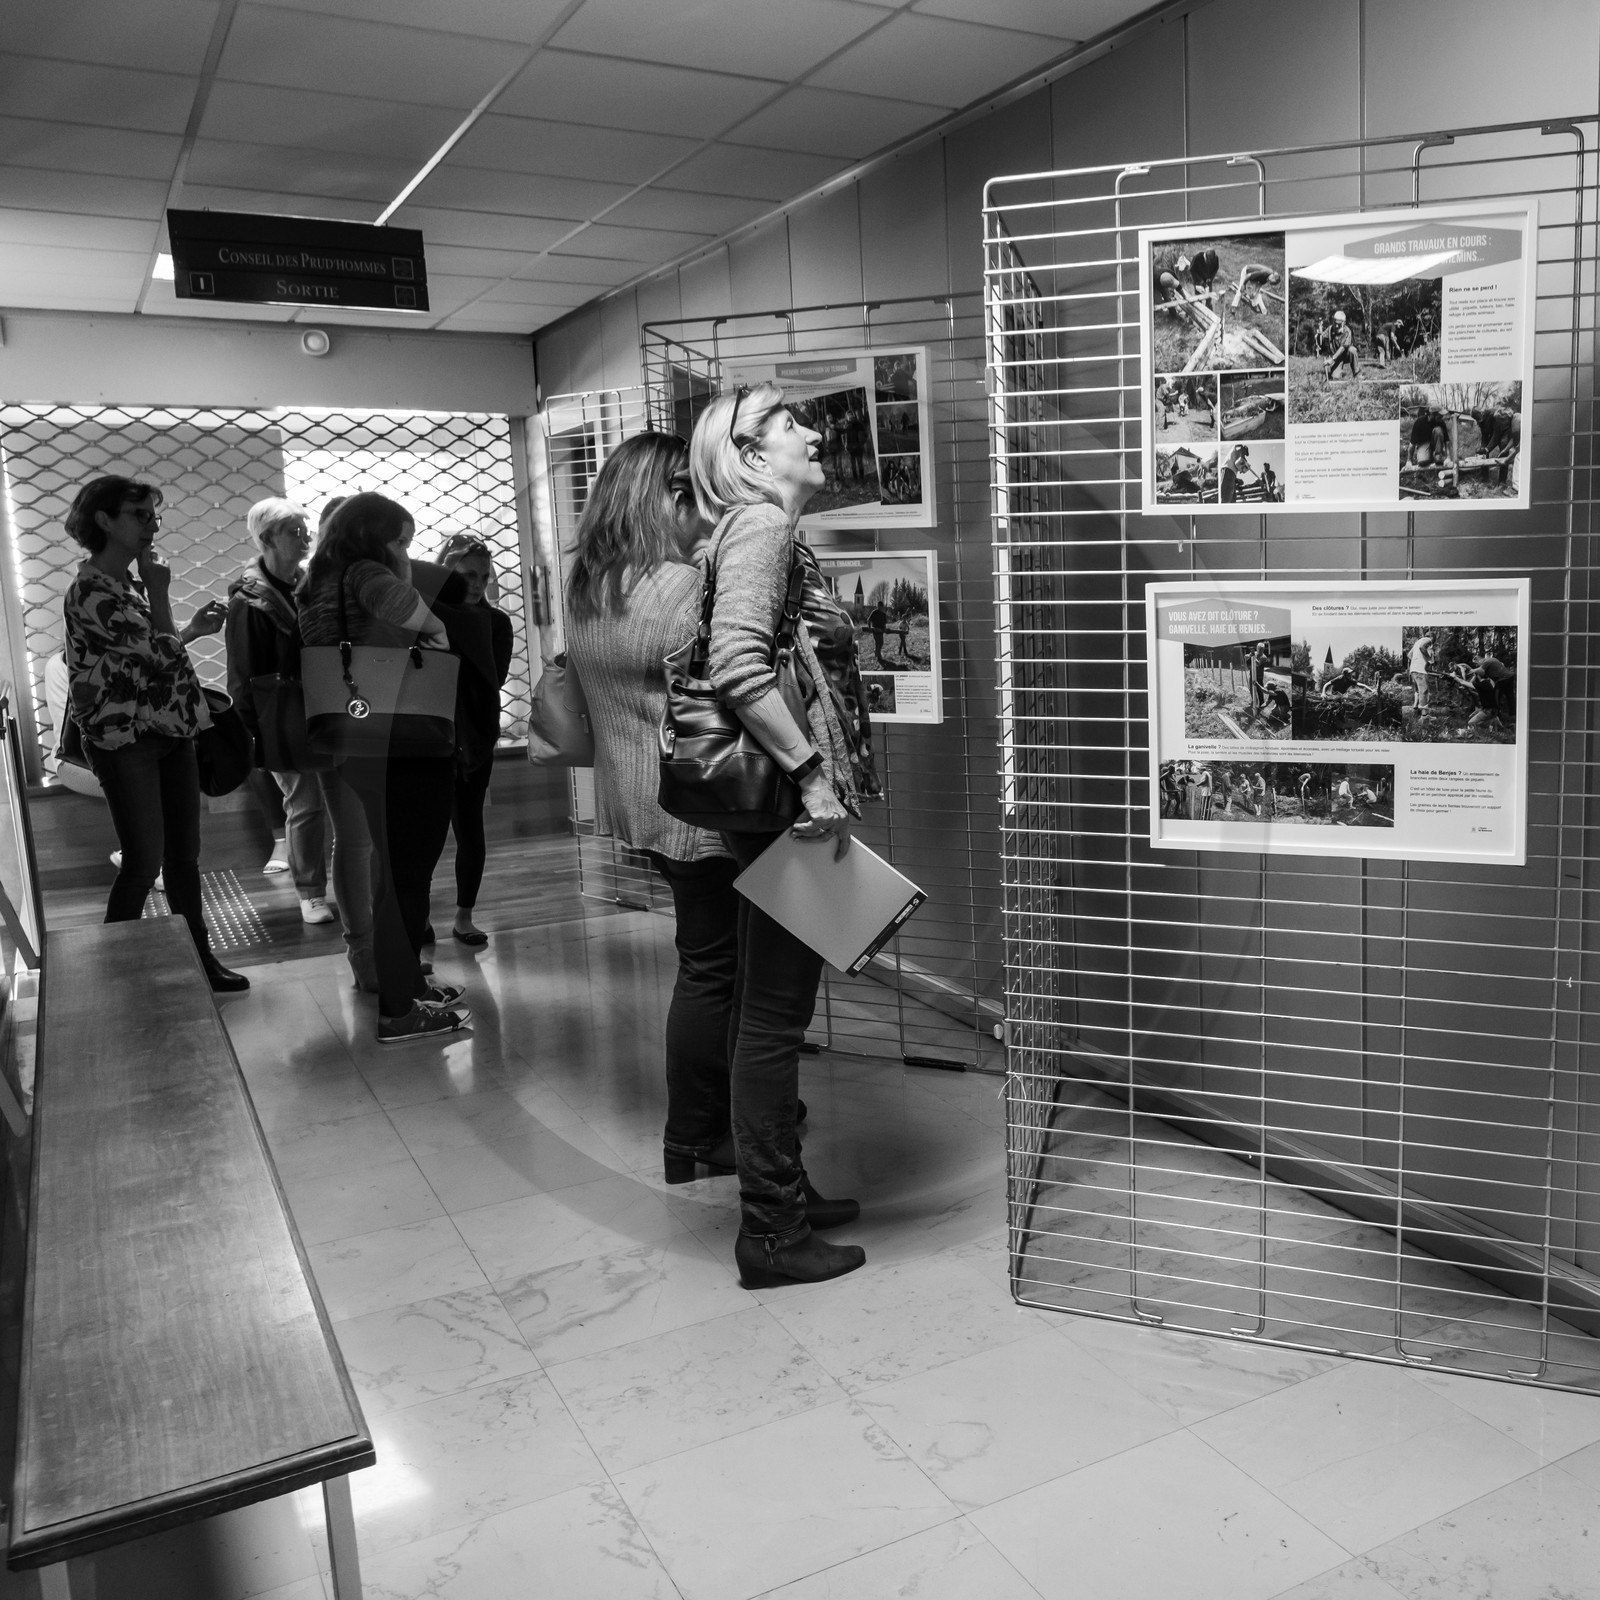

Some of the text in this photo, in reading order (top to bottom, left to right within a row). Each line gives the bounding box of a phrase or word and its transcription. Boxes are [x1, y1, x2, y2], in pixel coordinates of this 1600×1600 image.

[1374, 240, 1406, 254] GRANDS
[1408, 238, 1445, 251] TRAVAUX
[1447, 237, 1458, 248] EN
[1460, 235, 1487, 247] COURS
[276, 280, 339, 298] SORTIE
[1168, 609, 1258, 622] VOUS AVEZ DIT CLÔTURE ?
[1210, 624, 1226, 634] HAIE
[1228, 624, 1237, 634] DE
